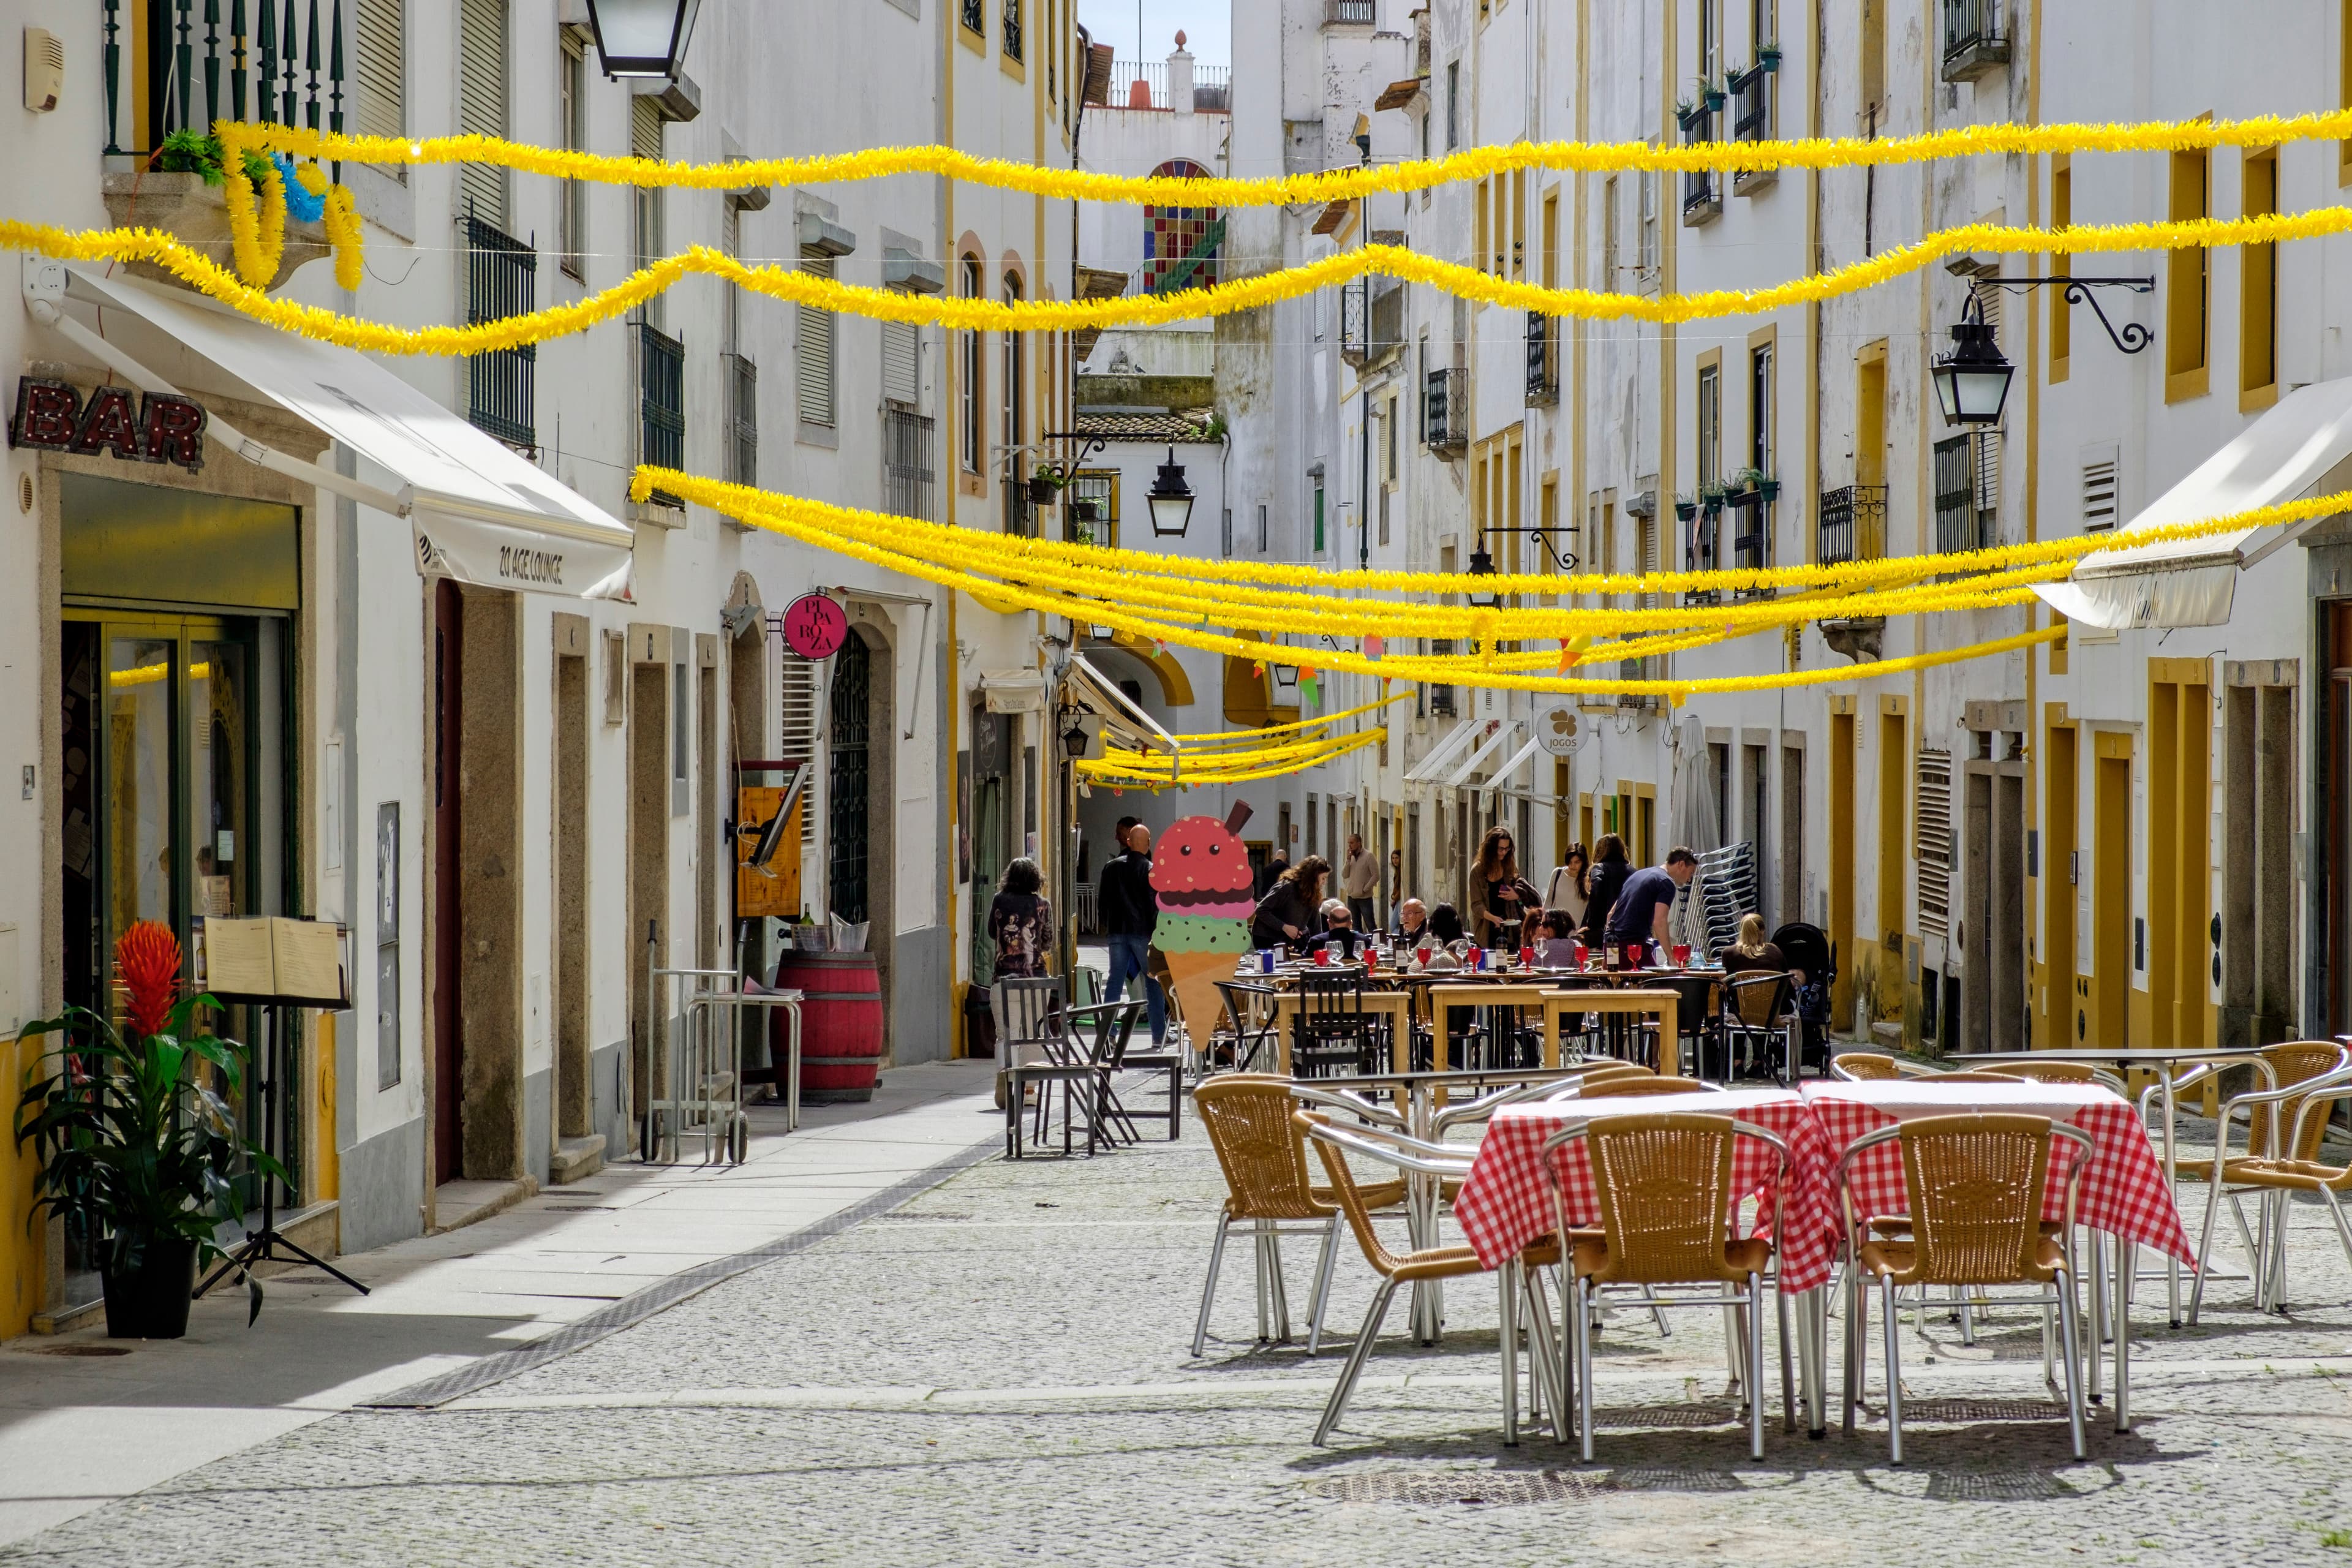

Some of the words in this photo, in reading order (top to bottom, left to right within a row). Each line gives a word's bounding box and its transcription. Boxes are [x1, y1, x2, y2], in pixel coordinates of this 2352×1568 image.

[16, 375, 208, 468] BAR
[499, 545, 511, 576] 20
[512, 548, 529, 580] AGE
[530, 551, 562, 584] LOUNGE
[805, 600, 820, 612] PI
[813, 612, 832, 625] PA
[800, 624, 822, 638] RO
[810, 637, 832, 650] ZA
[1550, 738, 1577, 749] JOGOS
